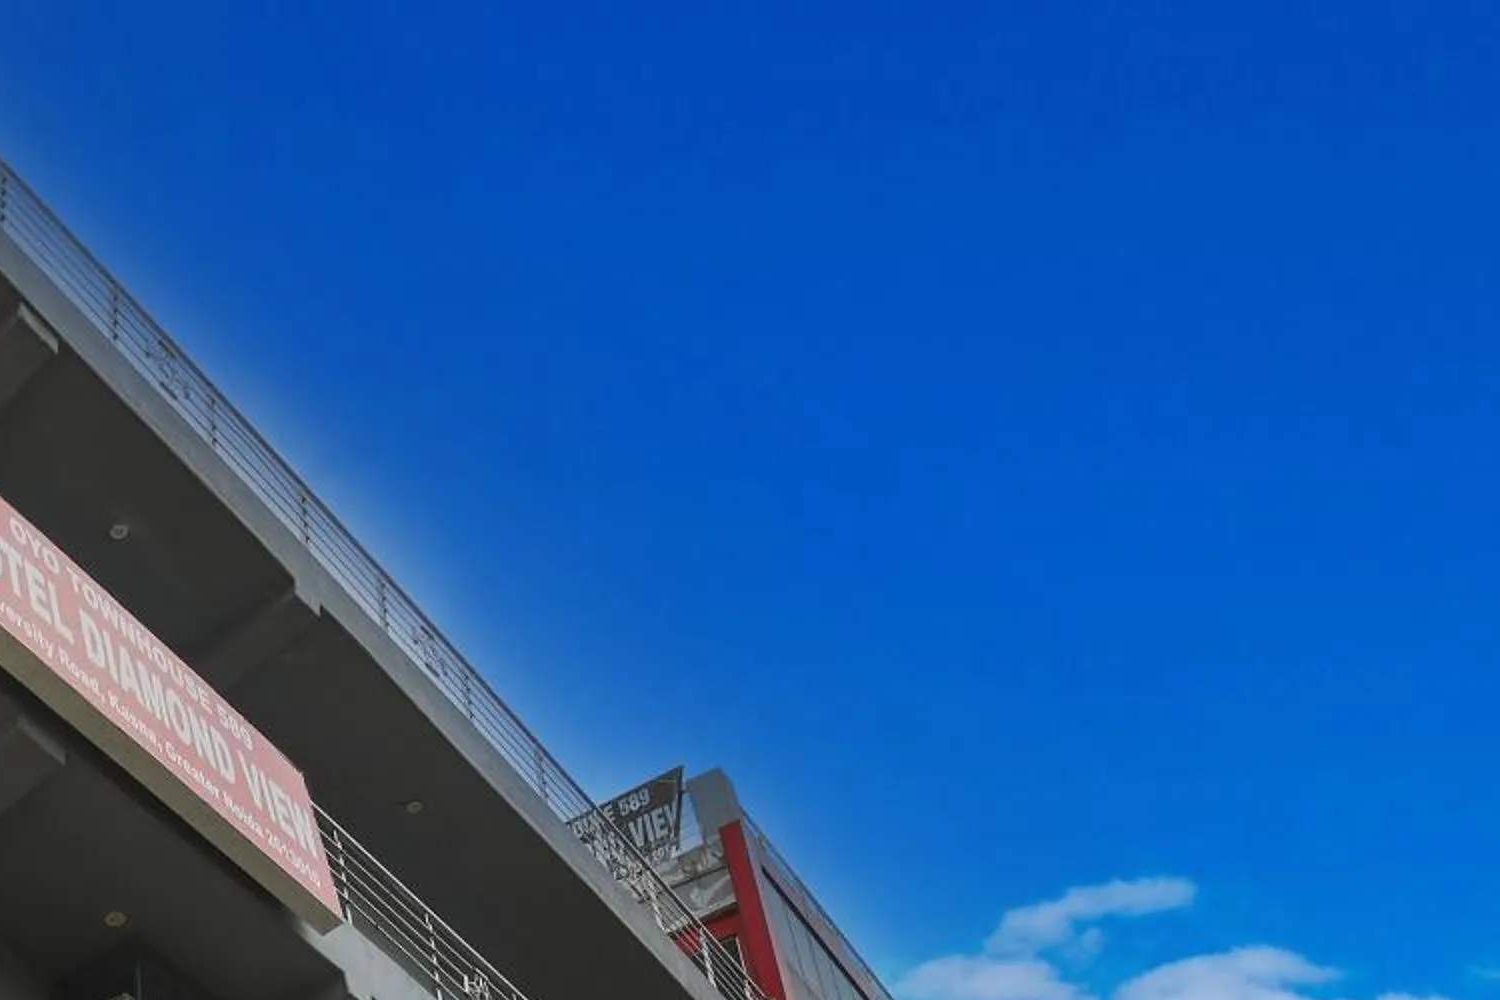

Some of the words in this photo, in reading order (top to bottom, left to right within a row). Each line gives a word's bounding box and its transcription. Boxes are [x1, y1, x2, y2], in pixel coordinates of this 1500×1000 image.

[9, 516, 60, 574] OYO
[66, 565, 213, 715] TOWNHOUSE
[78, 606, 236, 785] DIAMOND
[236, 750, 320, 862] VIEW
[165, 740, 221, 799] Greater
[617, 786, 651, 817] 589
